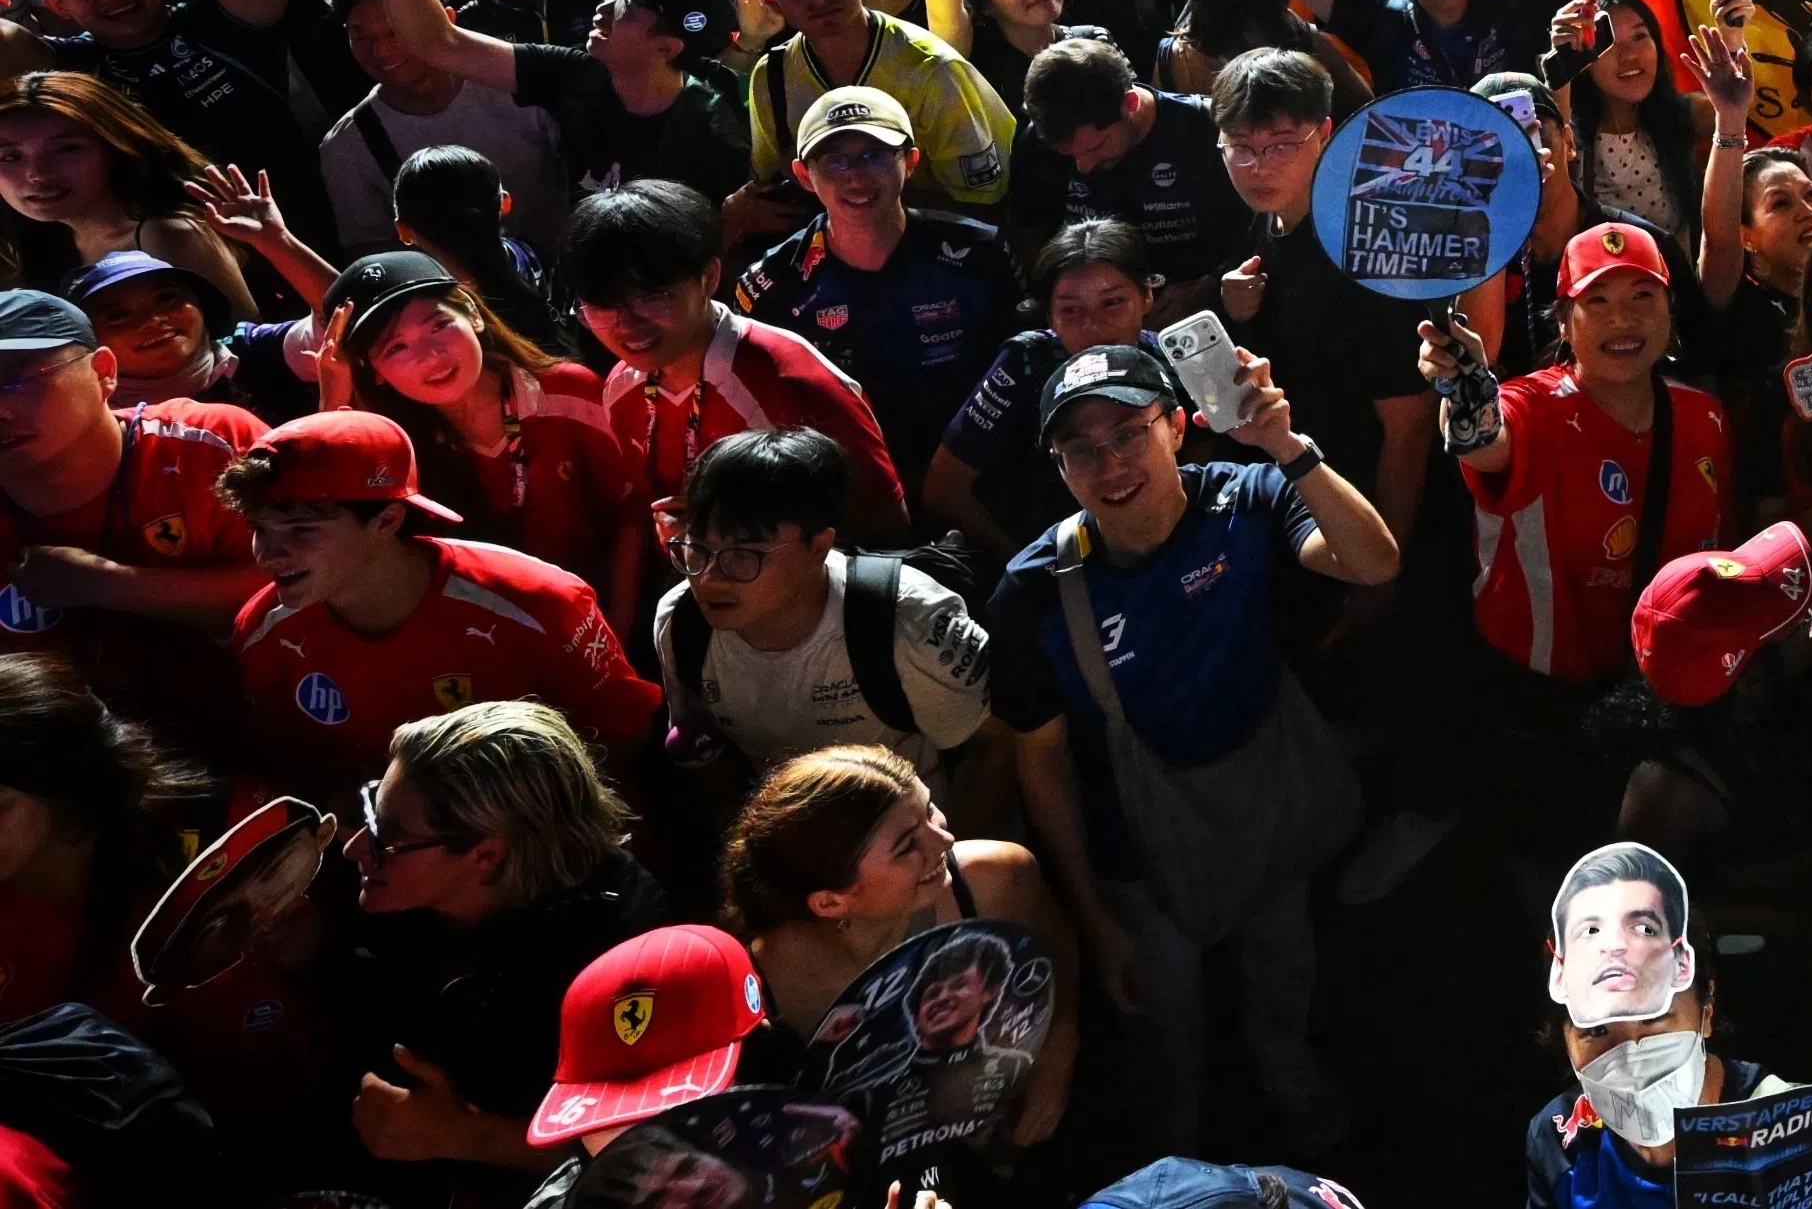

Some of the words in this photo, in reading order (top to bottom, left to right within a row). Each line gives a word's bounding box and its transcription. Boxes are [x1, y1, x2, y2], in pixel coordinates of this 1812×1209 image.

[684, 13, 706, 30] hp
[177, 56, 213, 86] INEOS
[201, 83, 235, 109] HPE
[1402, 145, 1464, 181] 44
[1143, 202, 1192, 213] Williams
[1355, 200, 1407, 229] IT'S
[1141, 216, 1196, 231] DURACELL
[1352, 226, 1481, 259] HAMMER
[1350, 250, 1428, 275] TIME!
[820, 306, 846, 316] TAG
[994, 369, 1011, 386] SAP
[965, 404, 987, 427] AMD
[1181, 553, 1226, 584] ORACE
[1780, 567, 1806, 600] 44
[925, 614, 953, 646] VISA
[1101, 613, 1126, 652] 3
[308, 673, 344, 723] hp
[863, 966, 908, 1011] 12
[1011, 1020, 1032, 1044] 12
[546, 1095, 598, 1125] 16
[1711, 1192, 1760, 1207] CALL
